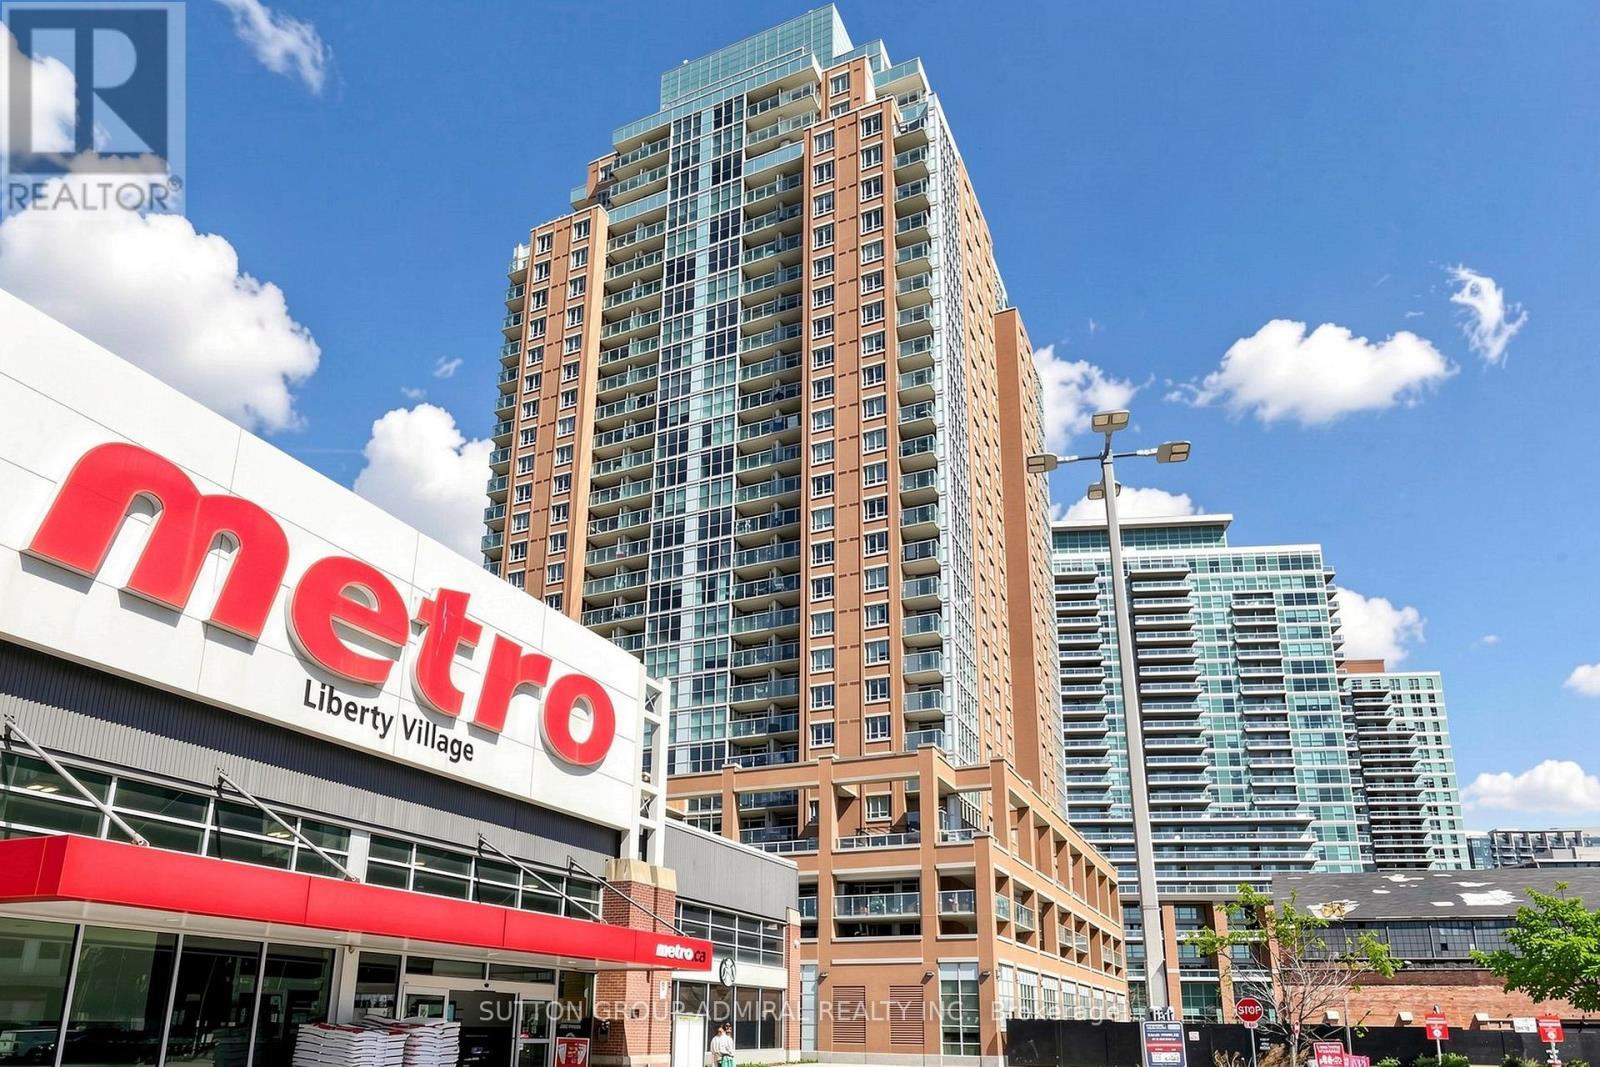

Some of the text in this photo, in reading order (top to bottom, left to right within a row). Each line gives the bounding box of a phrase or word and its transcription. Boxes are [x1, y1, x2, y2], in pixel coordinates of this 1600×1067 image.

[24, 442, 616, 767] metro
[303, 679, 474, 764] Liberty Village
[655, 943, 706, 963] metro.ca
[1237, 1005, 1261, 1015] STOP
